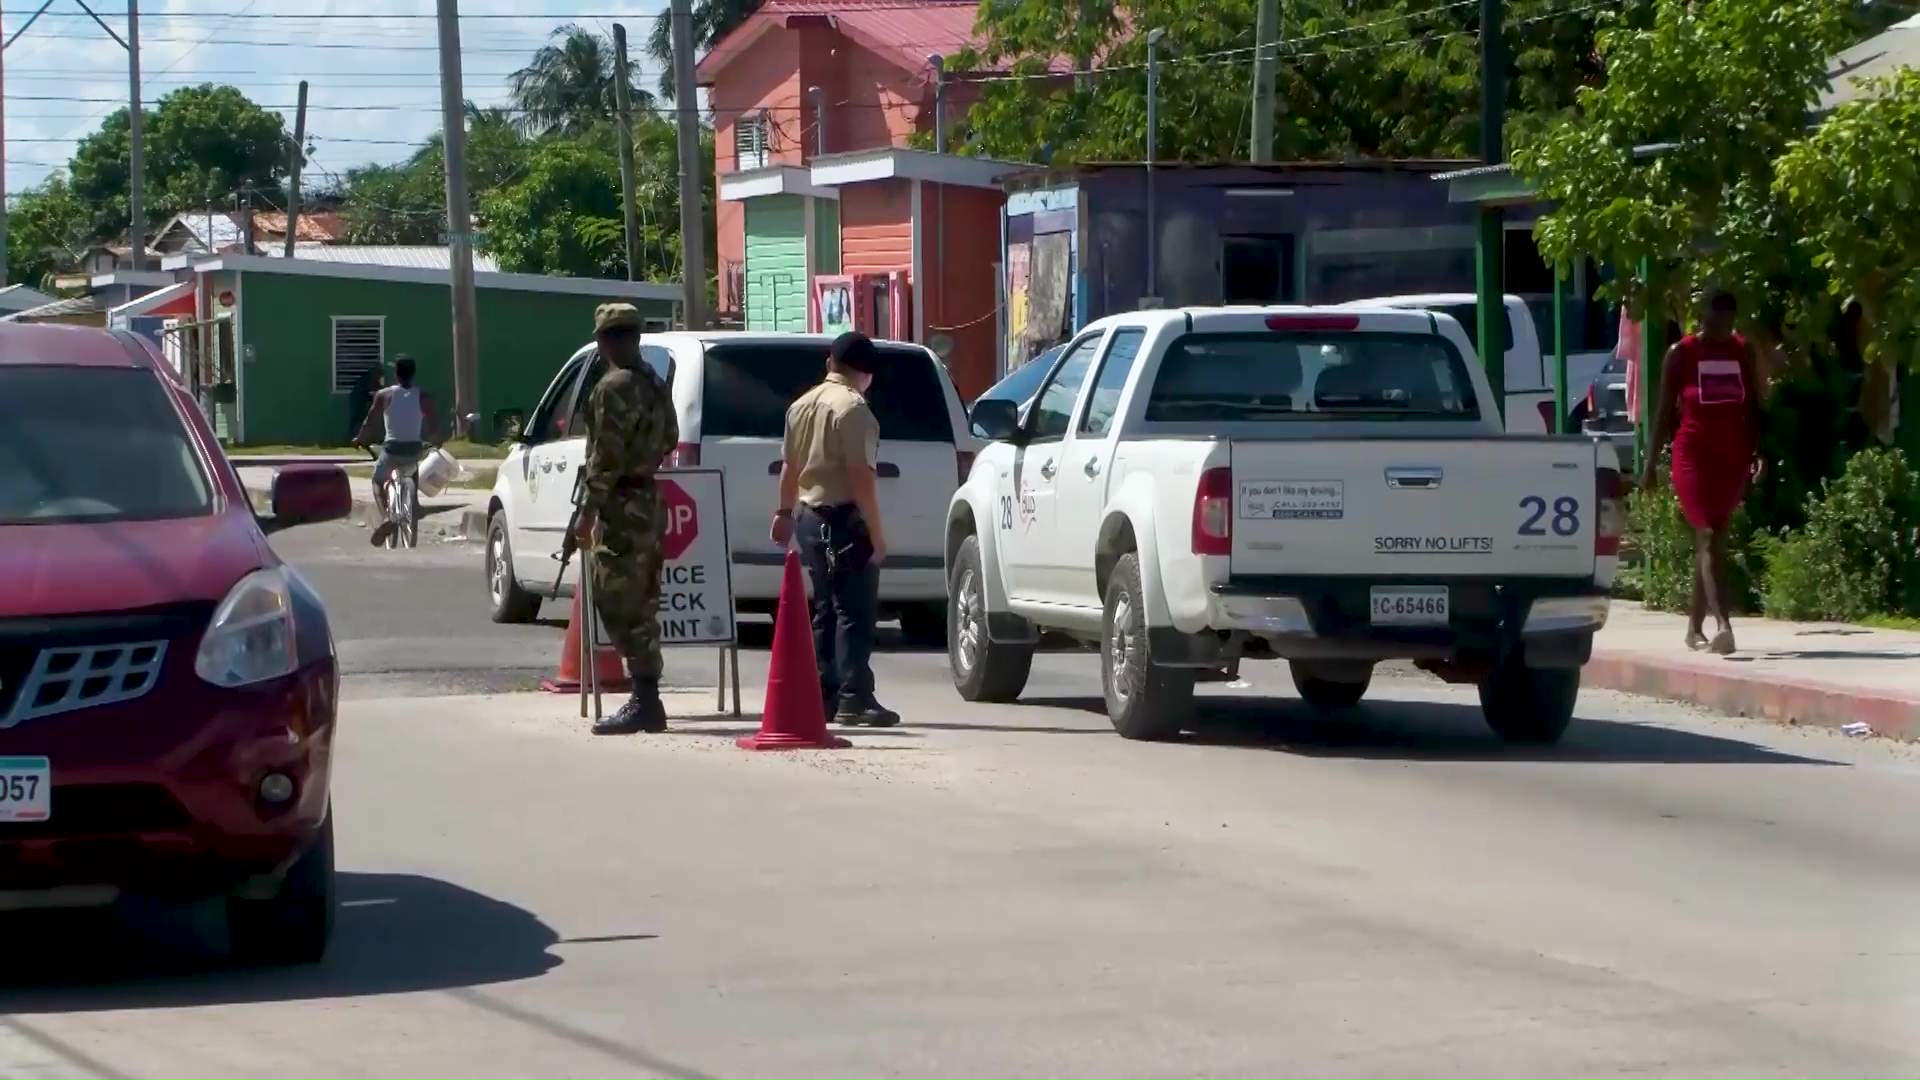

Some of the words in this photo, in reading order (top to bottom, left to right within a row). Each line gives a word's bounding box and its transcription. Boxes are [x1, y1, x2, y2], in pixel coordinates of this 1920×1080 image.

[1249, 488, 1262, 497] you
[1263, 486, 1281, 496] don't
[1001, 495, 1013, 530] 28
[1517, 495, 1580, 536] 28
[1374, 537, 1421, 550] SORRY
[1425, 537, 1447, 550] NO
[1450, 537, 1494, 550] LIFTS!
[659, 593, 706, 612] ECK
[663, 619, 702, 638] INT
